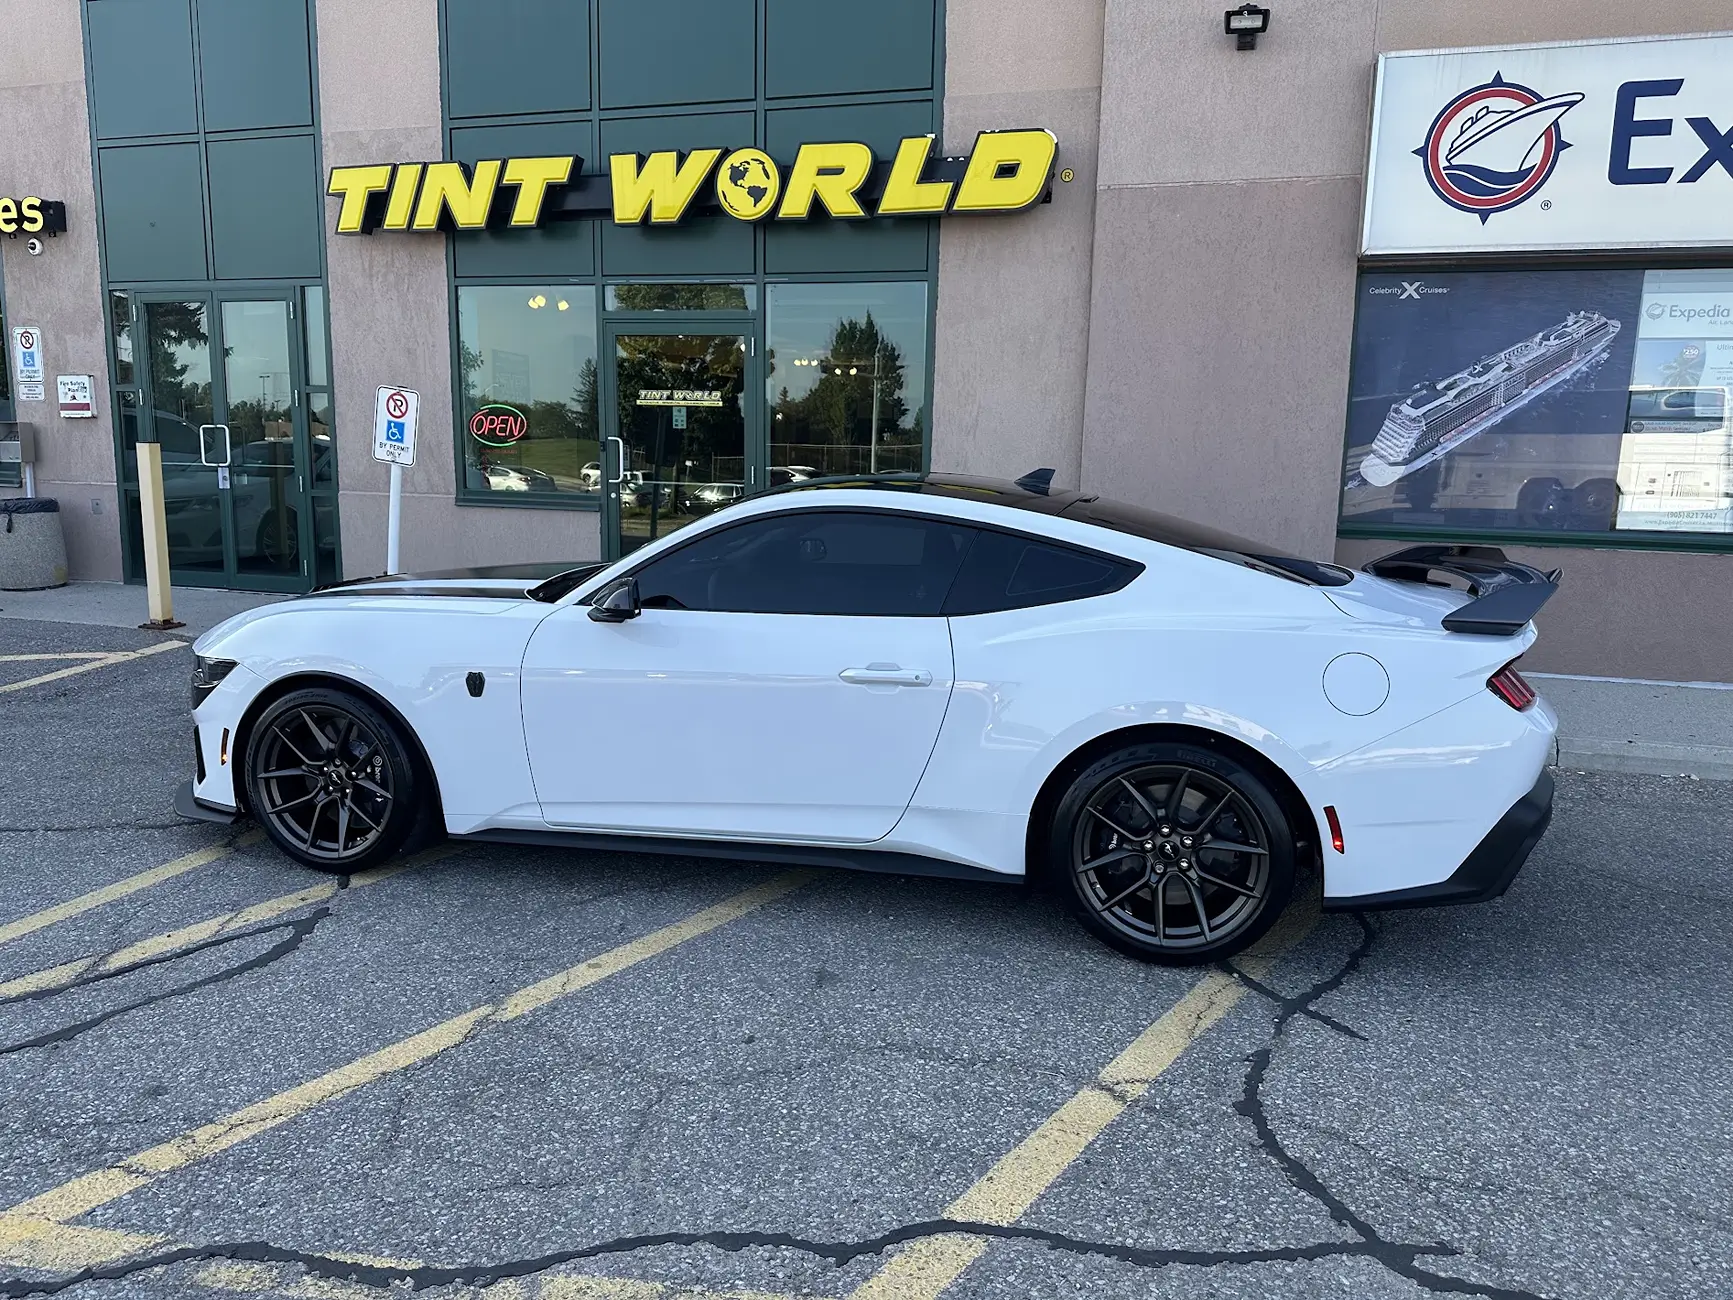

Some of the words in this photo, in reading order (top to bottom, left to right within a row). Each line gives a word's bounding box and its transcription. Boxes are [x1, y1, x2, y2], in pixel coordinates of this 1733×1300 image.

[327, 152, 579, 235] TINT
[608, 129, 1058, 222] WORLD
[1369, 286, 1402, 295] Celebrity
[1419, 286, 1448, 294] Cruises
[1669, 304, 1731, 322] Expedia
[639, 389, 671, 400] TINT
[672, 389, 721, 401] WORLD
[473, 415, 521, 436] OPEN
[379, 441, 388, 449] BY
[389, 443, 410, 453] PERMIT
[386, 449, 402, 459] ONLY
[1667, 511, 1685, 519] (905)
[1686, 511, 1699, 519] 821
[1700, 512, 1718, 520] 7447
